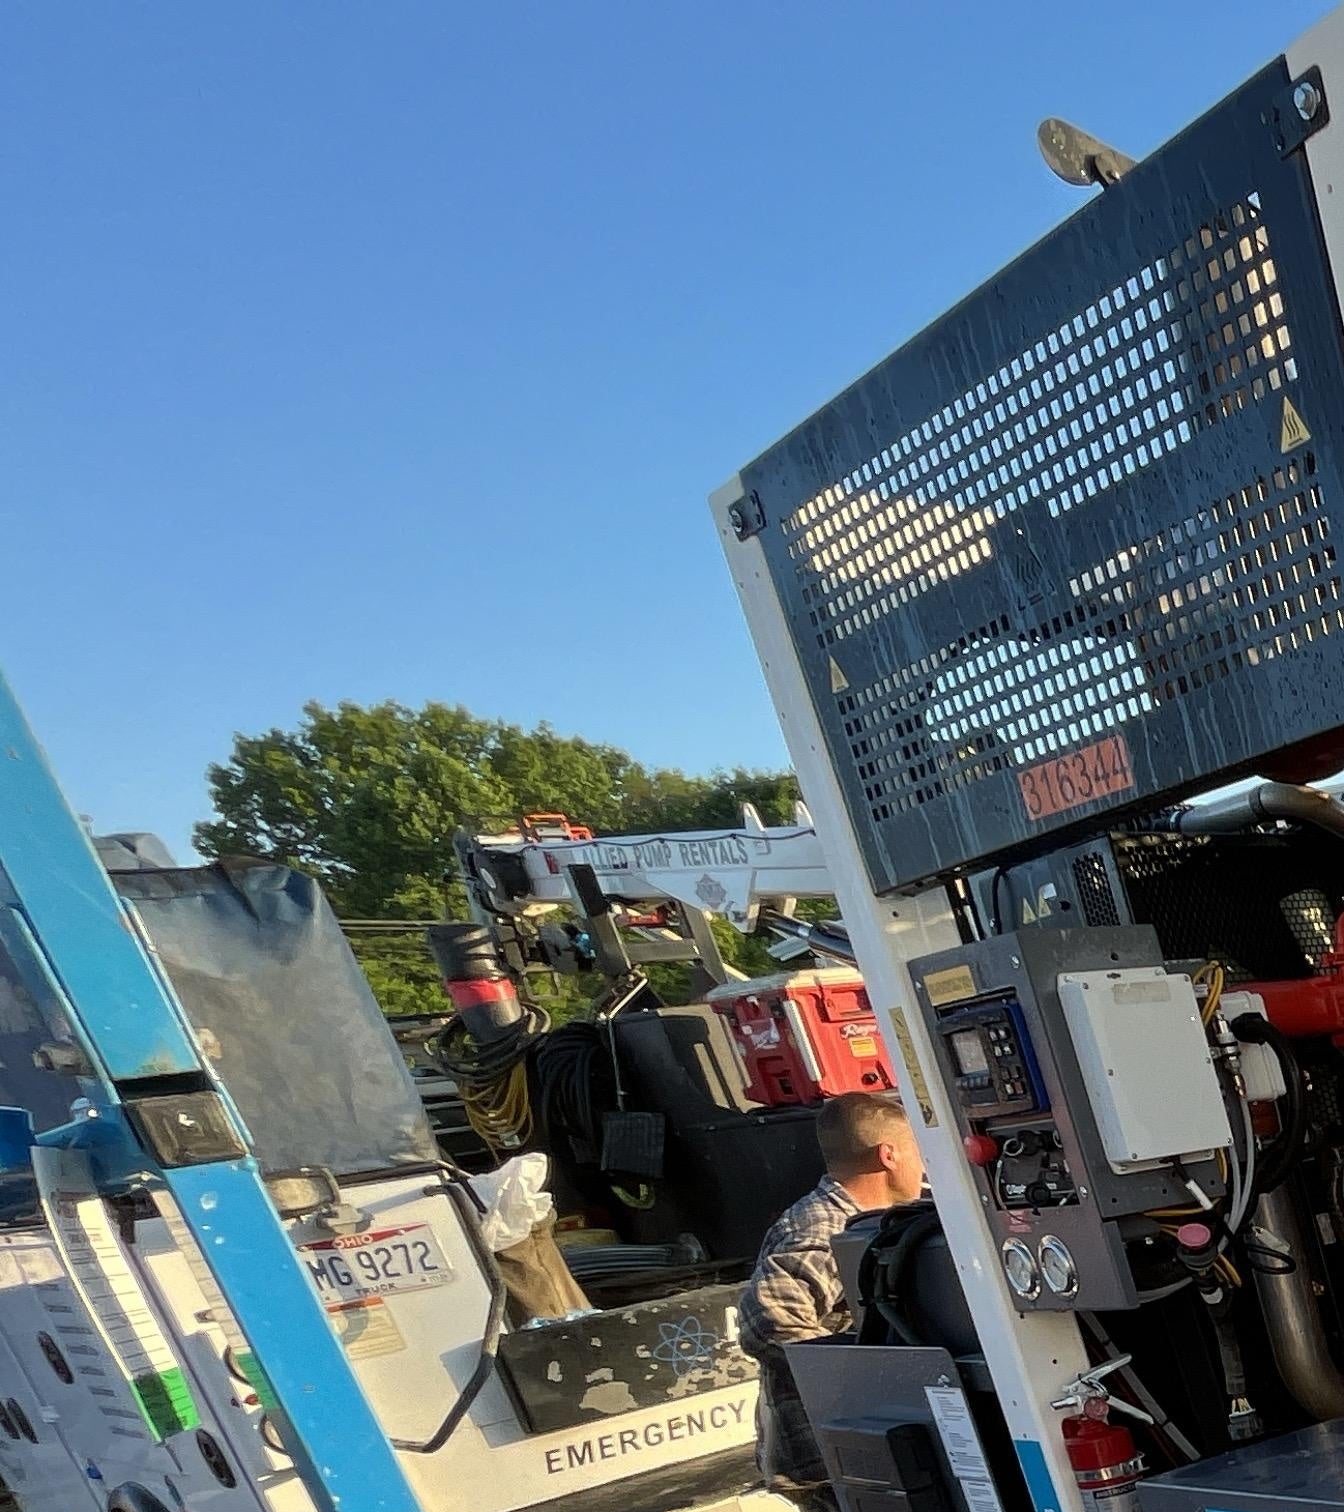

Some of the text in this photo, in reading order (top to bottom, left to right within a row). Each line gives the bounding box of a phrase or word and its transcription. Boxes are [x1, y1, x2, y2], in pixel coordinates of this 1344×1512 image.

[1021, 735, 1129, 815] 316344
[582, 837, 749, 870] ALLIED PUMP RENTALS
[332, 1234, 374, 1249] OHIO
[356, 1240, 439, 1281] 9272
[355, 1282, 397, 1296] TRUCK
[544, 1399, 746, 1475] EMERGENCY
